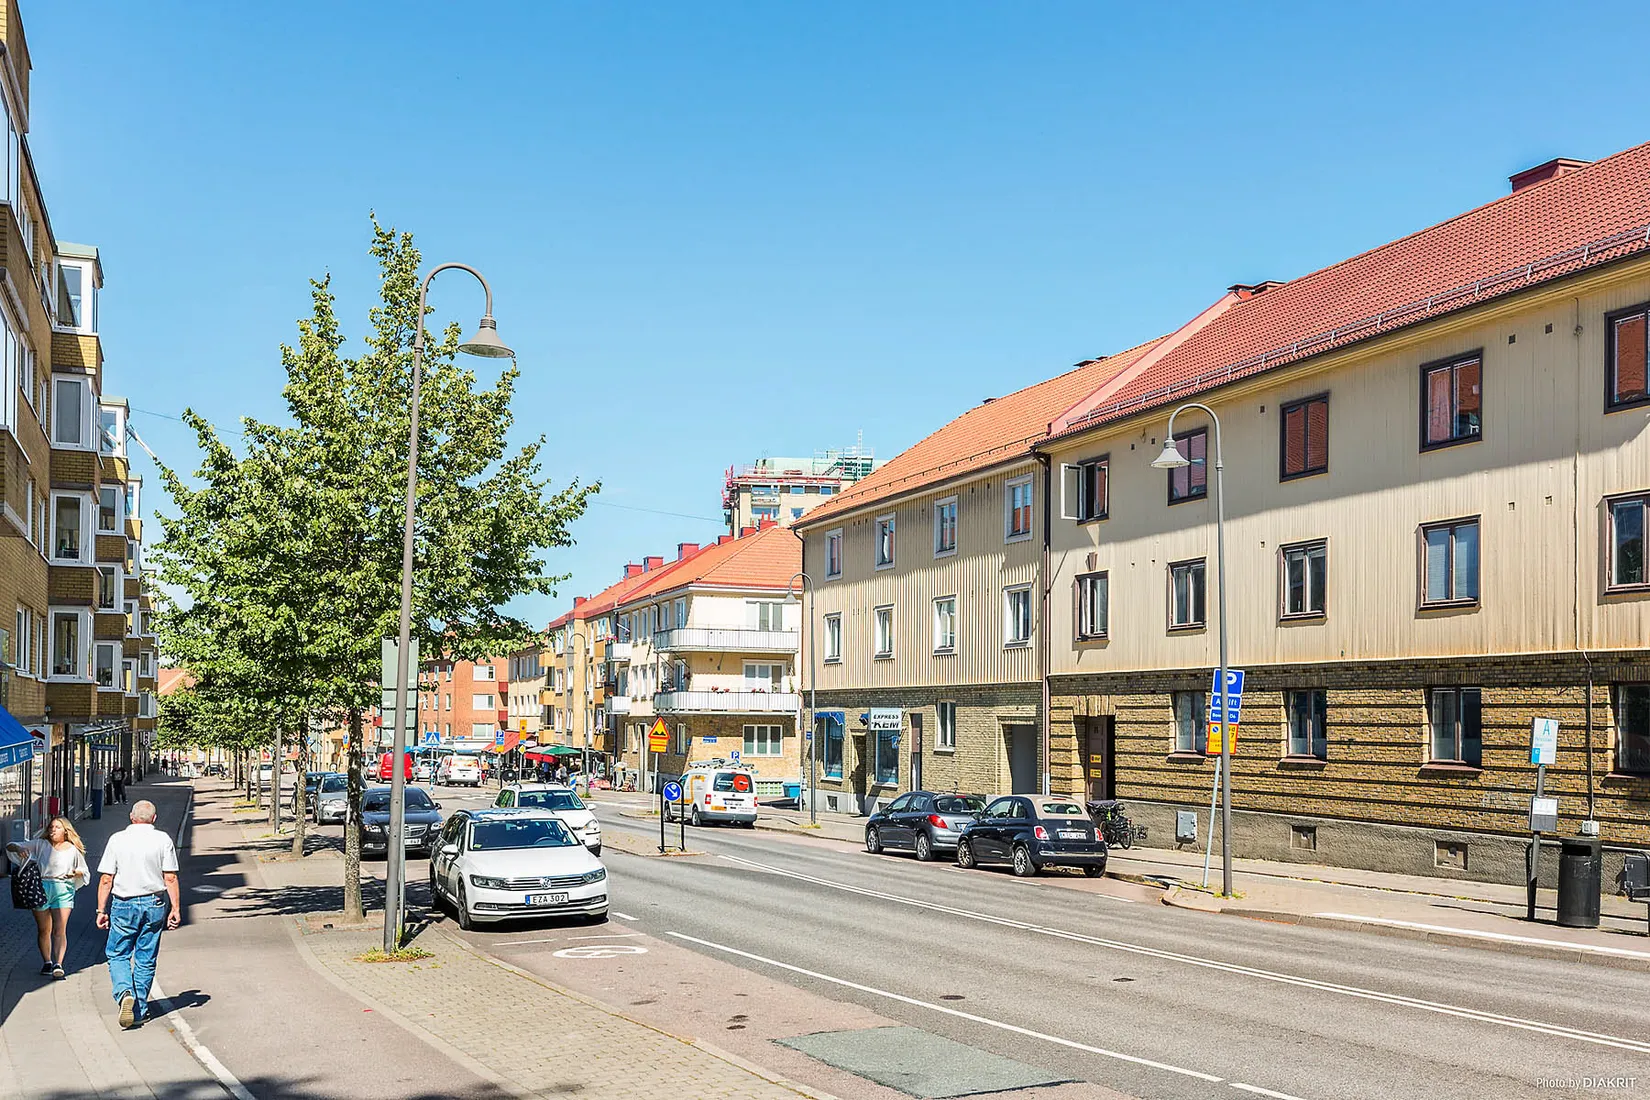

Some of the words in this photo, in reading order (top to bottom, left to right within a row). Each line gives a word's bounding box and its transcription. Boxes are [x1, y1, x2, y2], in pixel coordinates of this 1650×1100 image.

[1215, 698, 1237, 706] Aift
[873, 721, 899, 729] KEM
[1543, 720, 1550, 736] A
[532, 895, 548, 904] EZA
[550, 894, 565, 903] 302
